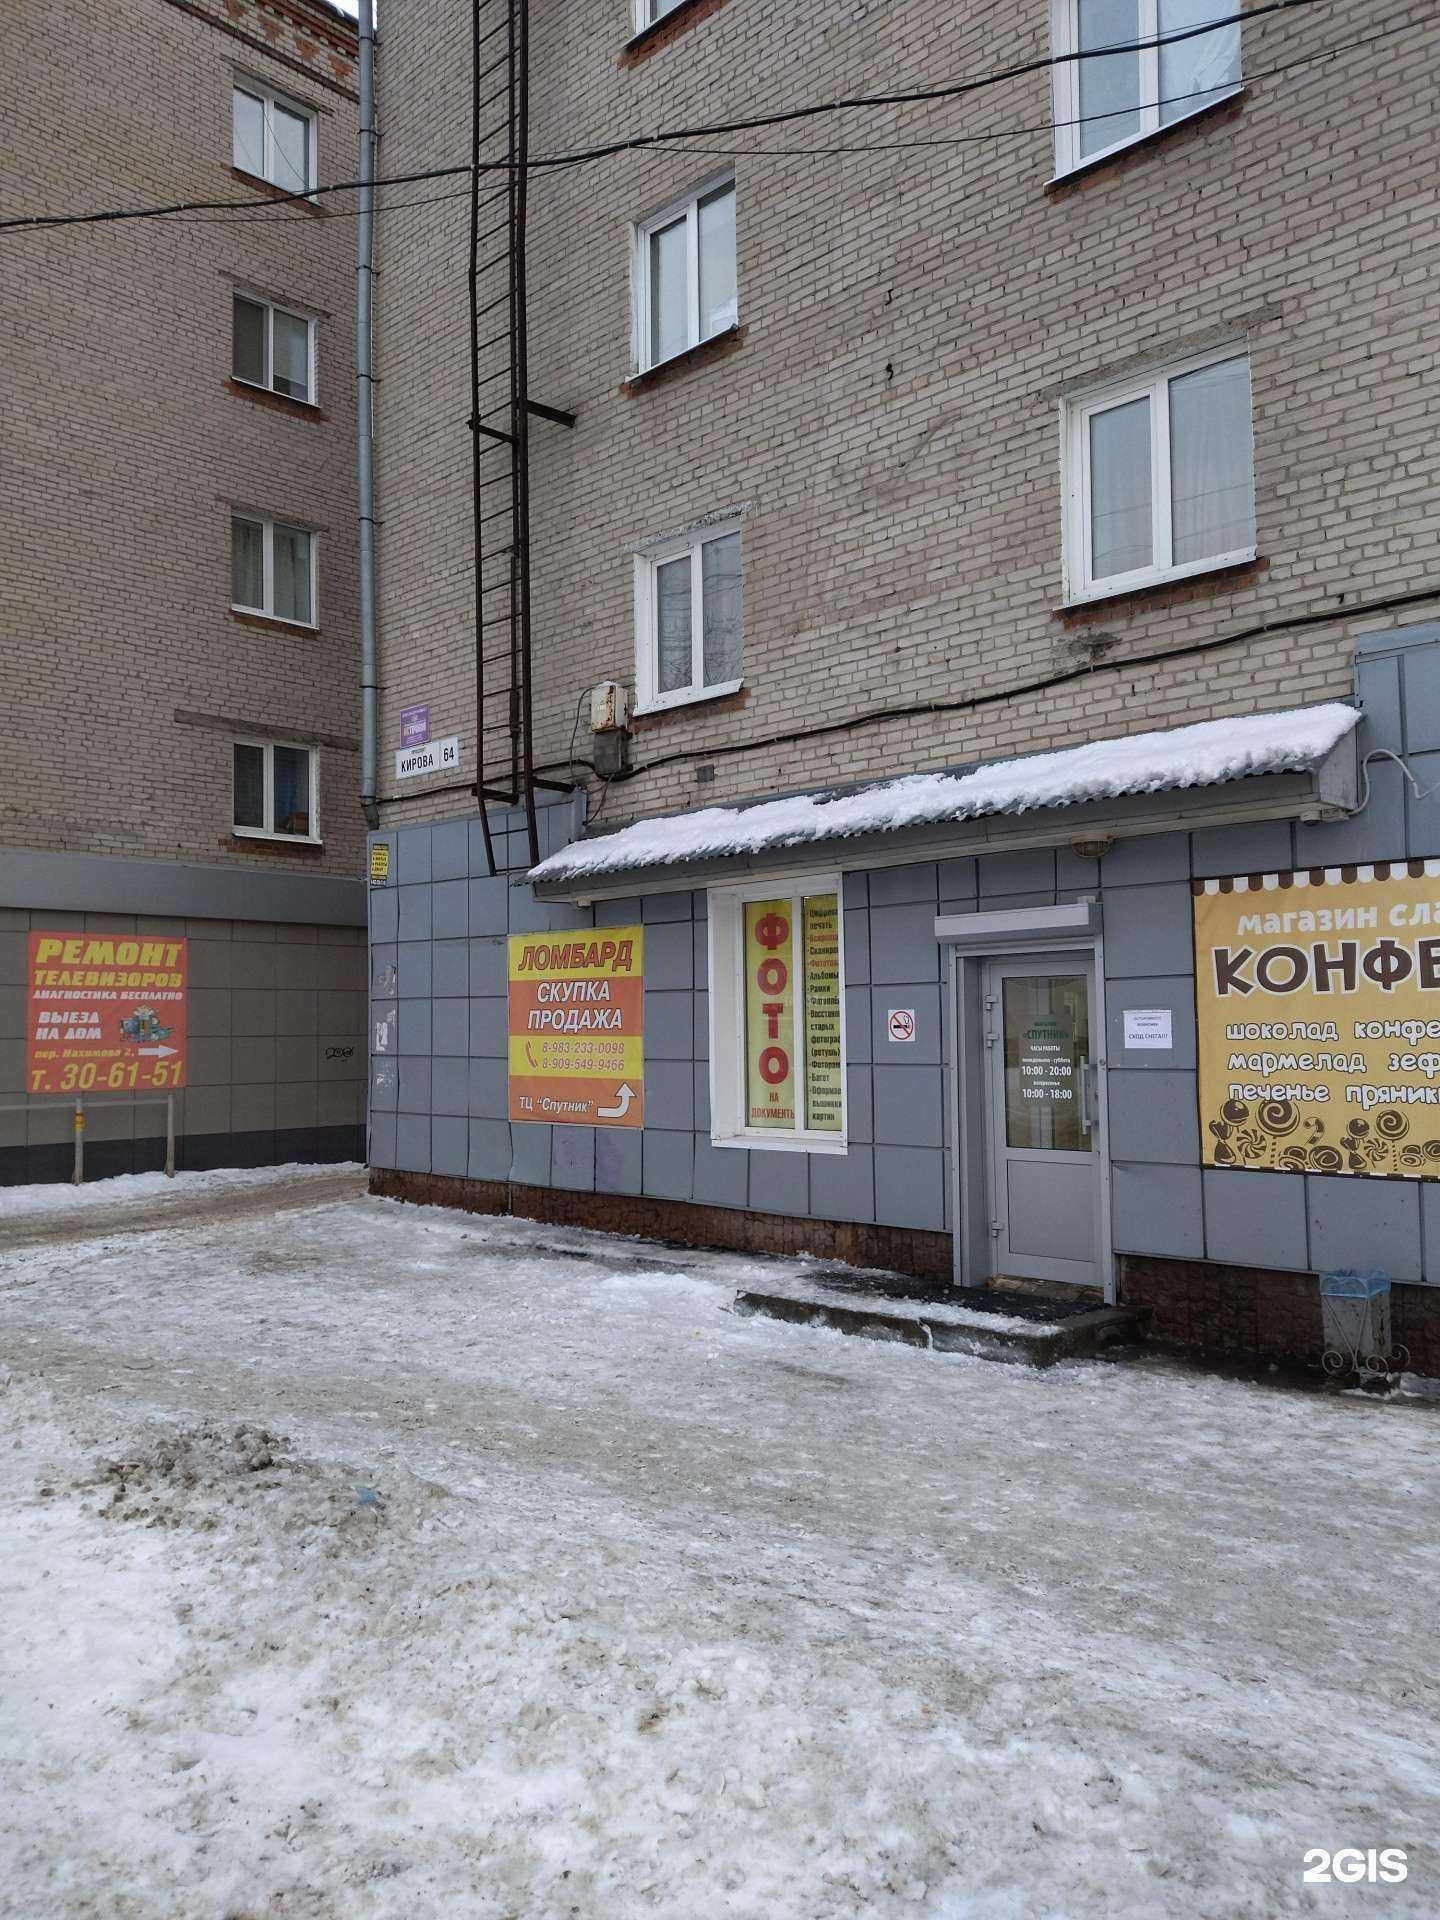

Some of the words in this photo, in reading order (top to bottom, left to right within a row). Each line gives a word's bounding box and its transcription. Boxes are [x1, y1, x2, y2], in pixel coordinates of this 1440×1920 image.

[401, 753, 434, 773] КИРОВА
[443, 746, 455, 762] 64
[1236, 904, 1378, 936] магазин
[35, 938, 183, 967] РЕМОНТ
[517, 940, 634, 972] ЛОМБАРД
[33, 969, 183, 988] ТЕЛЕВИЗОРОВ
[1212, 937, 1440, 998] КОНФЕ
[33, 990, 118, 1000] ДИАГНОСТИКА
[120, 991, 183, 1001] БЕСПЛАТНО
[537, 980, 611, 1003] СКУПКА
[755, 912, 790, 1085] ФОТО
[810, 985, 831, 993] Рамки
[38, 1011, 100, 1024] ВЫЕЗД
[527, 1008, 623, 1034] ПРОДАЖА
[811, 1023, 835, 1031] старых
[35, 1027, 59, 1040] НА
[64, 1027, 102, 1040] ДОМ
[1225, 1021, 1340, 1042] шоколад
[1353, 1018, 1440, 1046] конфе
[63, 1048, 121, 1057] Нахимова
[60, 1061, 183, 1090] 30-61-51
[1022, 1066, 1044, 1076] 10:00
[1049, 1066, 1072, 1076] 20:00
[1226, 1051, 1368, 1077] мармелад
[1387, 1051, 1440, 1079] зеф
[519, 1096, 533, 1112] ТЦ
[769, 1091, 779, 1102] НА
[1022, 1088, 1044, 1098] 10:00
[1050, 1089, 1073, 1099] 18:00
[1227, 1082, 1331, 1102] печенье
[1345, 1083, 1440, 1111] пряник
